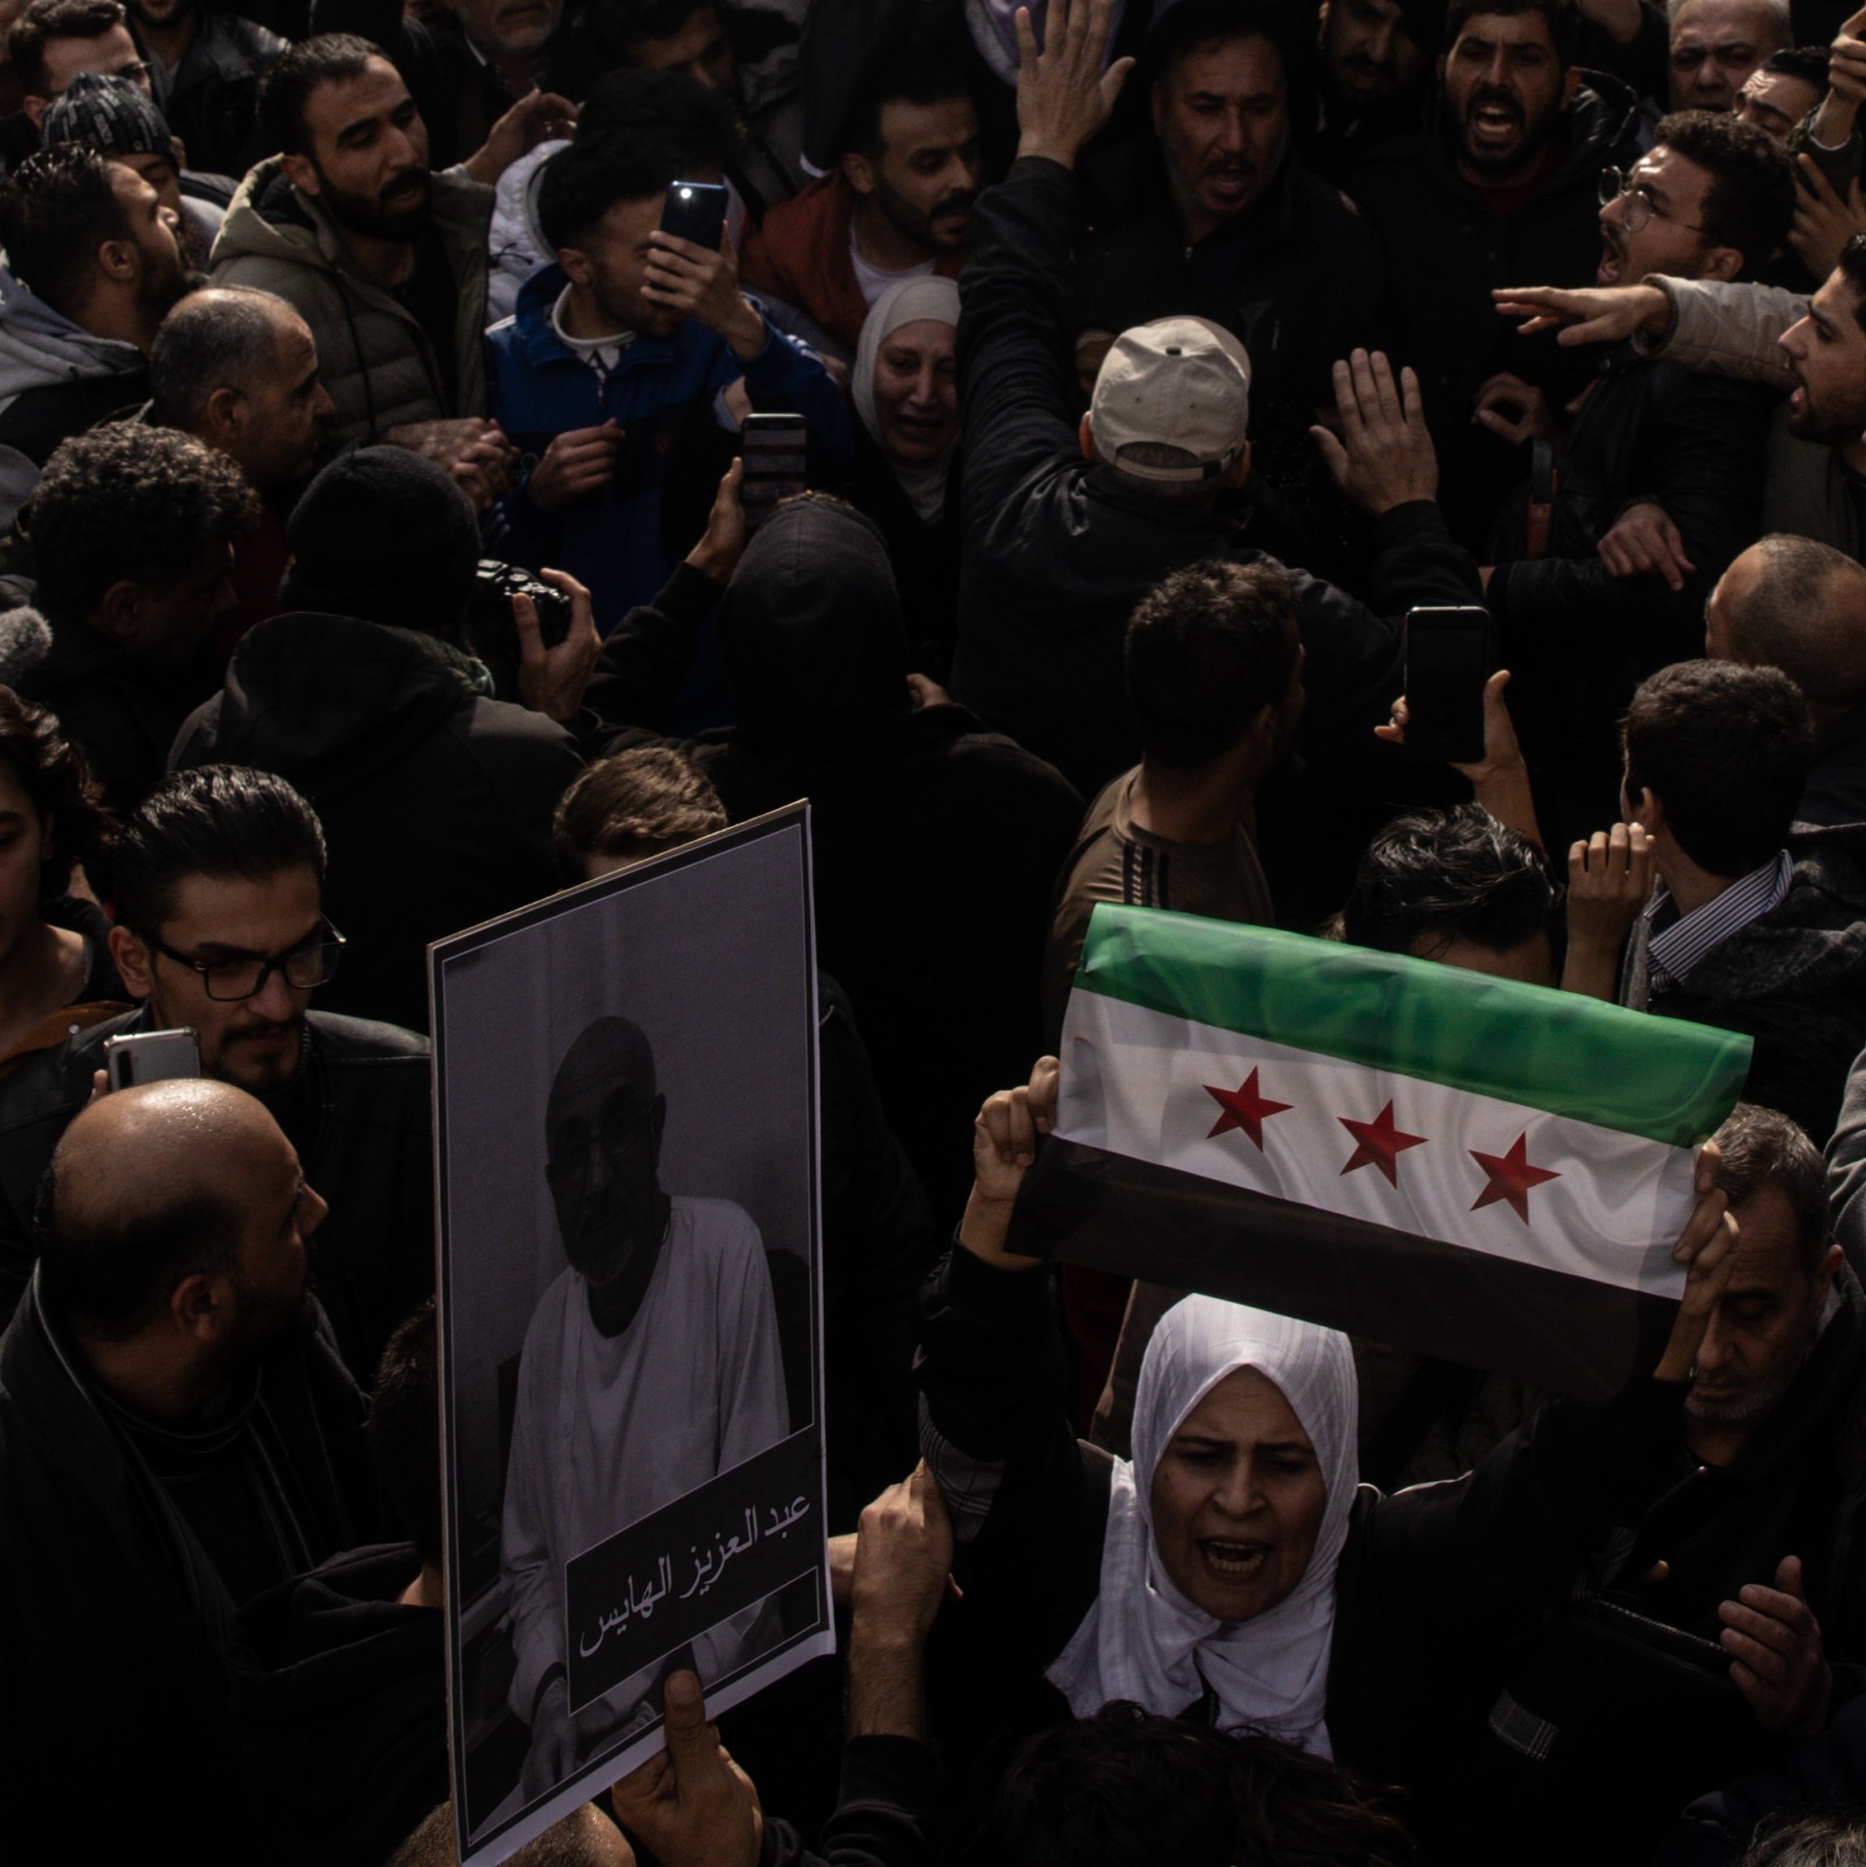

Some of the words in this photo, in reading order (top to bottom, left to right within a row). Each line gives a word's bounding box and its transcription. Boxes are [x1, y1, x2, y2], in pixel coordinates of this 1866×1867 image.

[678, 1504, 758, 1599] العزيز
[763, 1495, 811, 1539] عبد
[579, 1552, 673, 1658] الهايس
